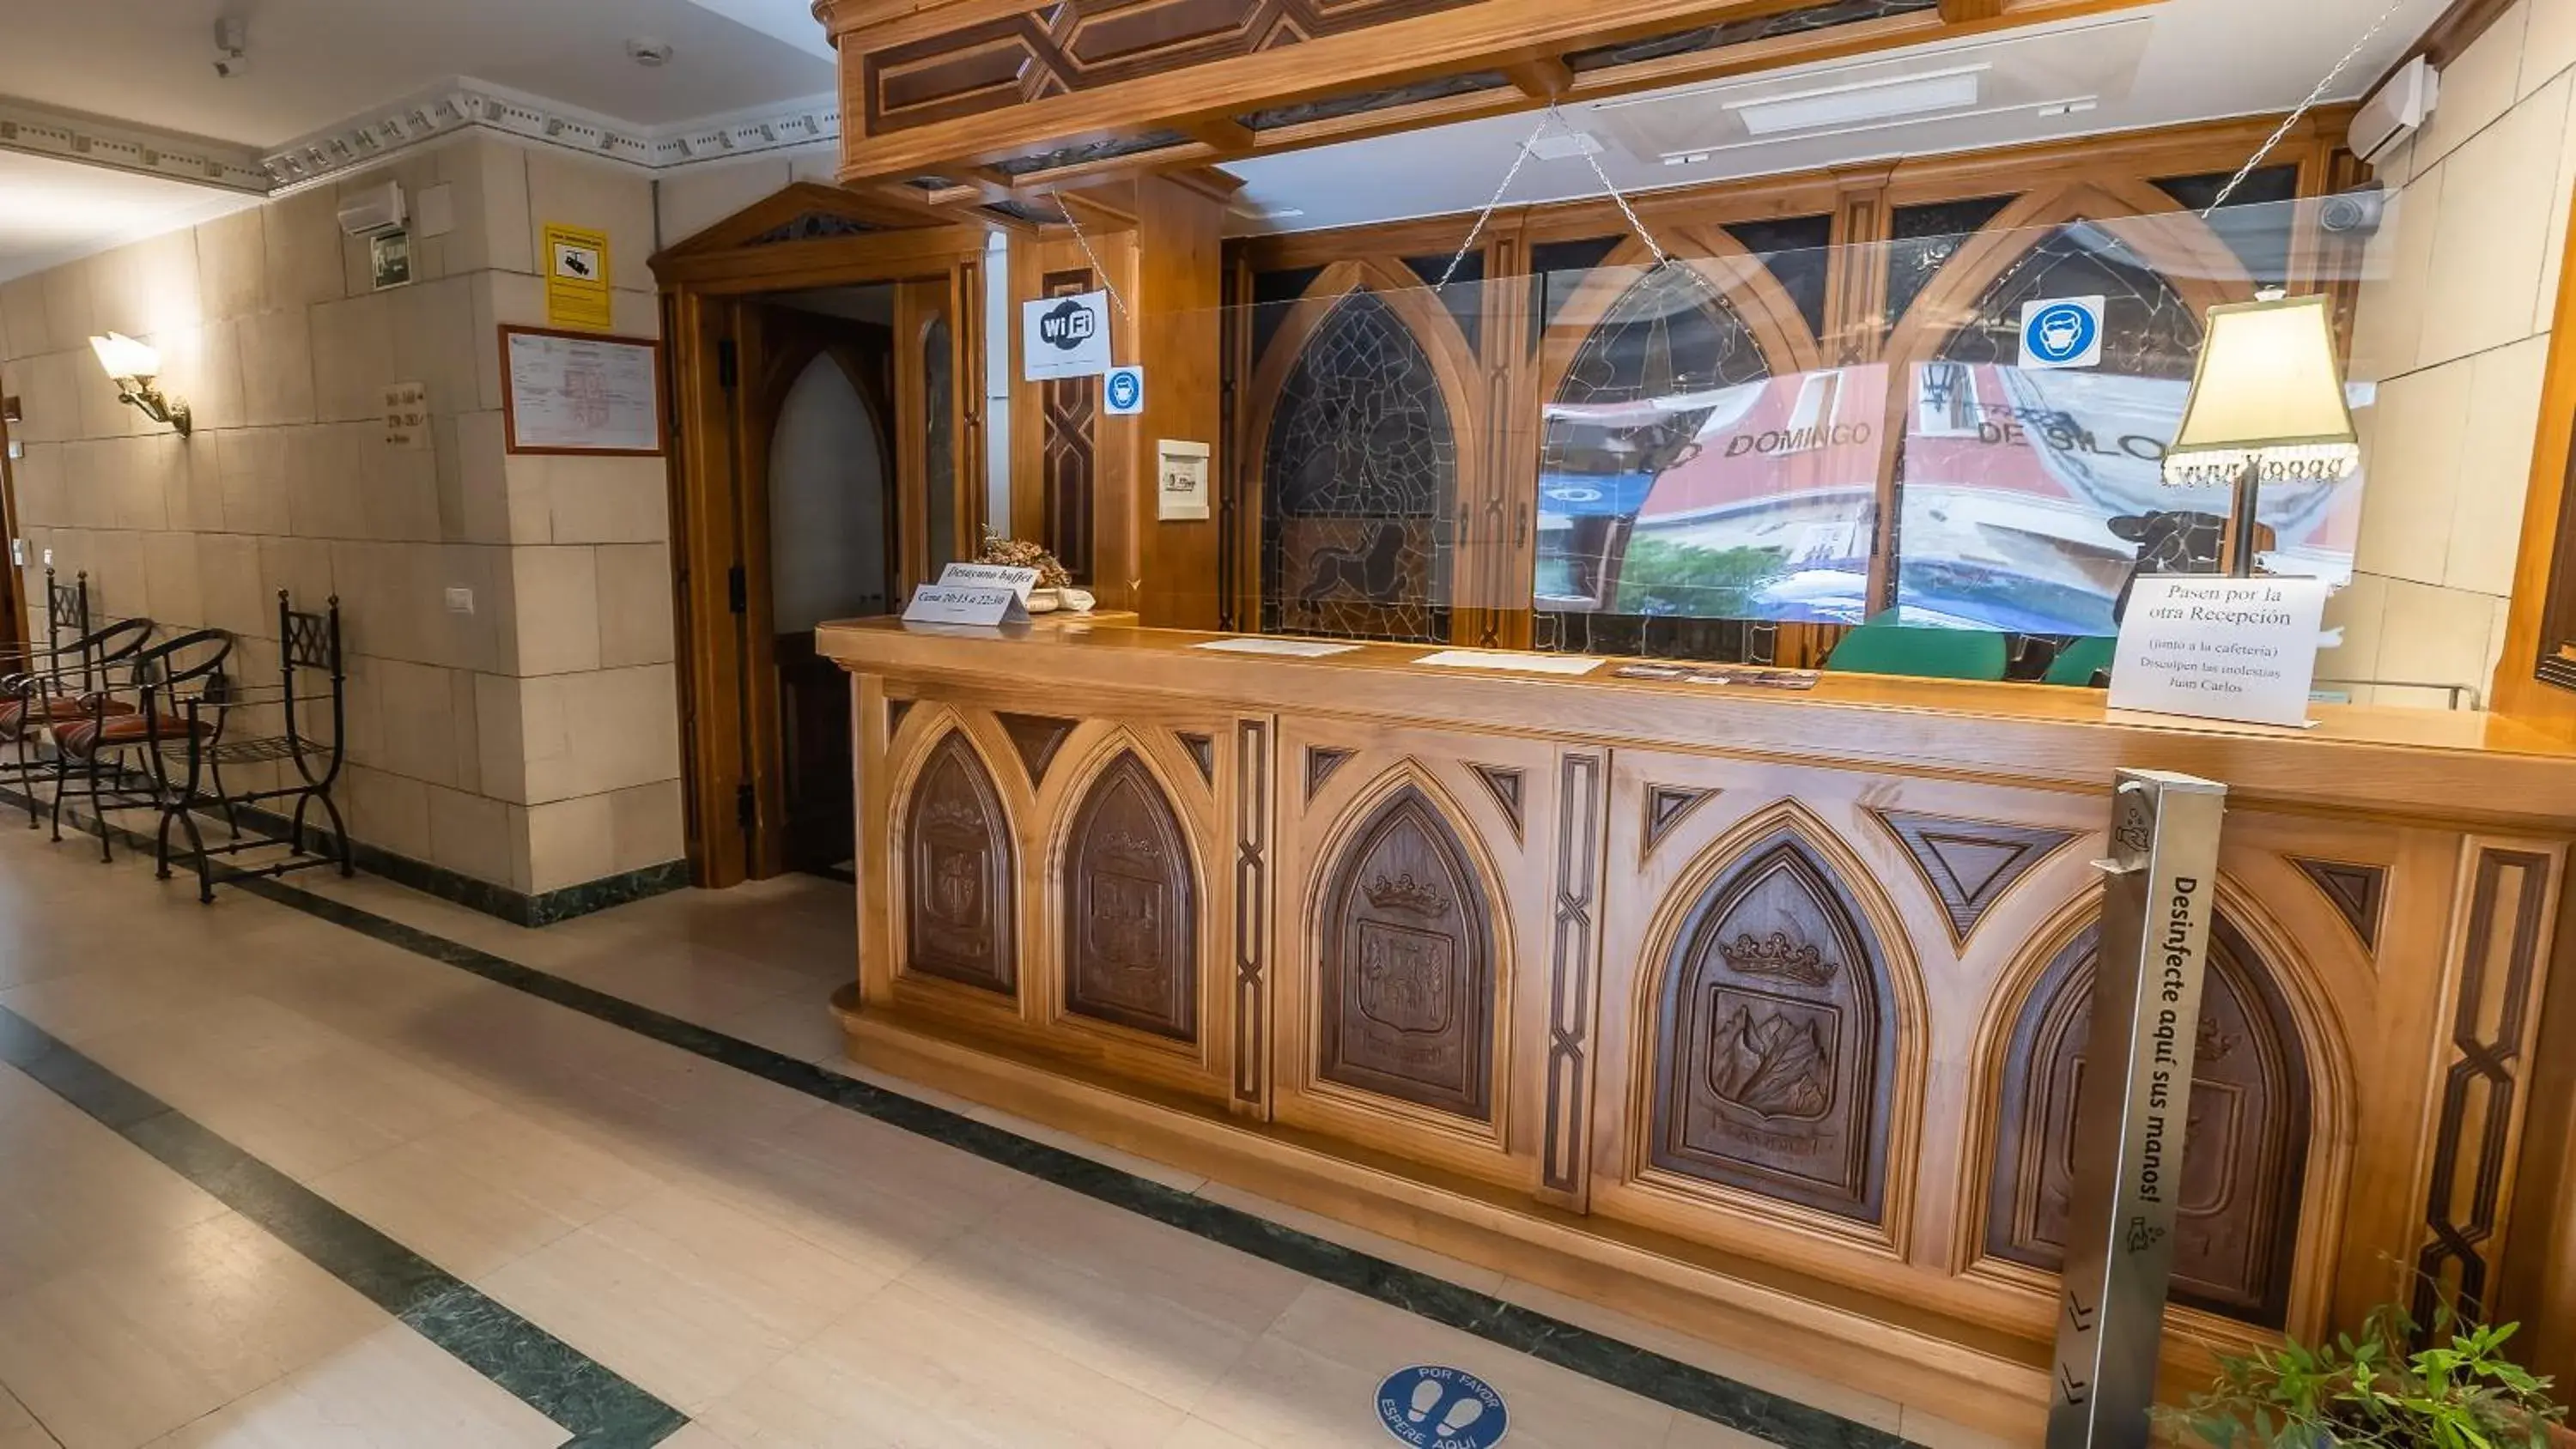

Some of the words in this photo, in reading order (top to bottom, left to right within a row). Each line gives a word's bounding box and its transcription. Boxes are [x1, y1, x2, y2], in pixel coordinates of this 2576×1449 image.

[1043, 314, 1090, 337] WiFi
[1725, 423, 1871, 458] DOMINGO
[1978, 421, 2031, 447] DE
[999, 569, 1033, 585] buffet
[2167, 585, 2220, 599] Pasen
[2226, 589, 2256, 603] por
[2264, 587, 2282, 603] la
[2149, 605, 2184, 620] otra
[2190, 607, 2293, 626] Recepción
[2149, 640, 2185, 651] (junto
[2189, 642, 2196, 651] a
[2200, 641, 2212, 652] la
[2141, 656, 2197, 671] Disculpen
[2202, 662, 2218, 673] las
[2221, 665, 2281, 679] molestias
[2170, 677, 2197, 690] Juan
[2201, 680, 2243, 694] Carlos
[2161, 876, 2197, 1003] Desinfecte
[2152, 1009, 2178, 1068] aquí
[2149, 1070, 2170, 1109] sus
[2139, 1116, 2165, 1203] manos!
[1419, 1367, 1453, 1379] POR
[1459, 1374, 1500, 1409] FAVOR
[1382, 1398, 1426, 1445] ESPERE
